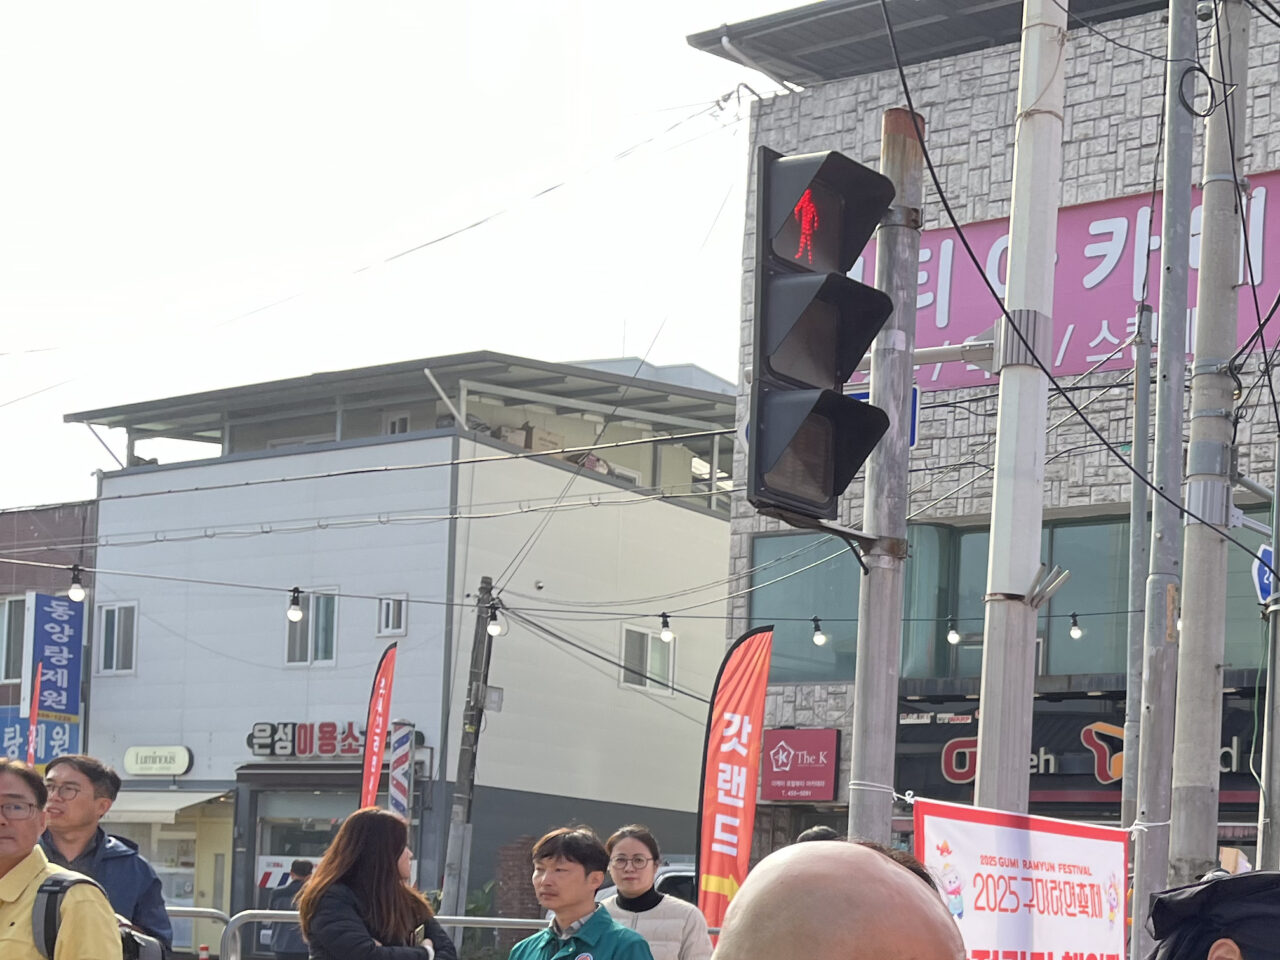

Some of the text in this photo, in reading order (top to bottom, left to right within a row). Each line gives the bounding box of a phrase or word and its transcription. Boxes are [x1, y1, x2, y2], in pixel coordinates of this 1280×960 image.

[252, 721, 363, 757] 은성이용소
[795, 750, 829, 765] The K
[711, 712, 752, 858] 갓랜드
[979, 855, 1093, 877] 2025 GUMI RAMYUN FESTIVAL
[973, 872, 1104, 919] 2025 구미라면축제
